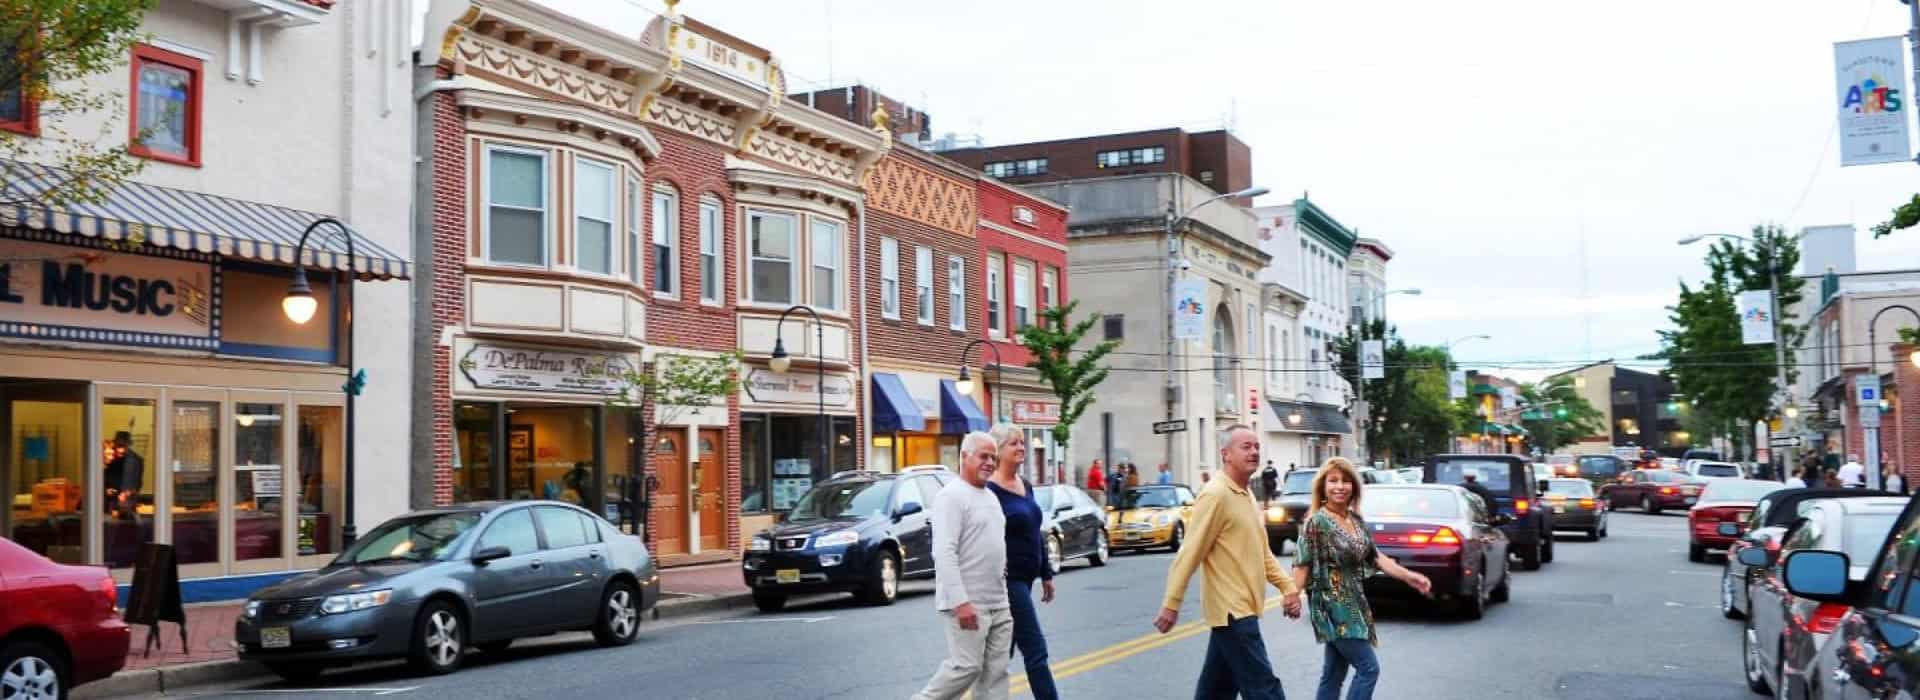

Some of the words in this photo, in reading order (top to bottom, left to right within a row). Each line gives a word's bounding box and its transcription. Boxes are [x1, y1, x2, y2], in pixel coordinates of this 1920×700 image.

[705, 40, 738, 69] 1914
[1843, 80, 1903, 113] ARTS
[42, 257, 177, 318] MUSIC
[485, 350, 564, 373] DePalma
